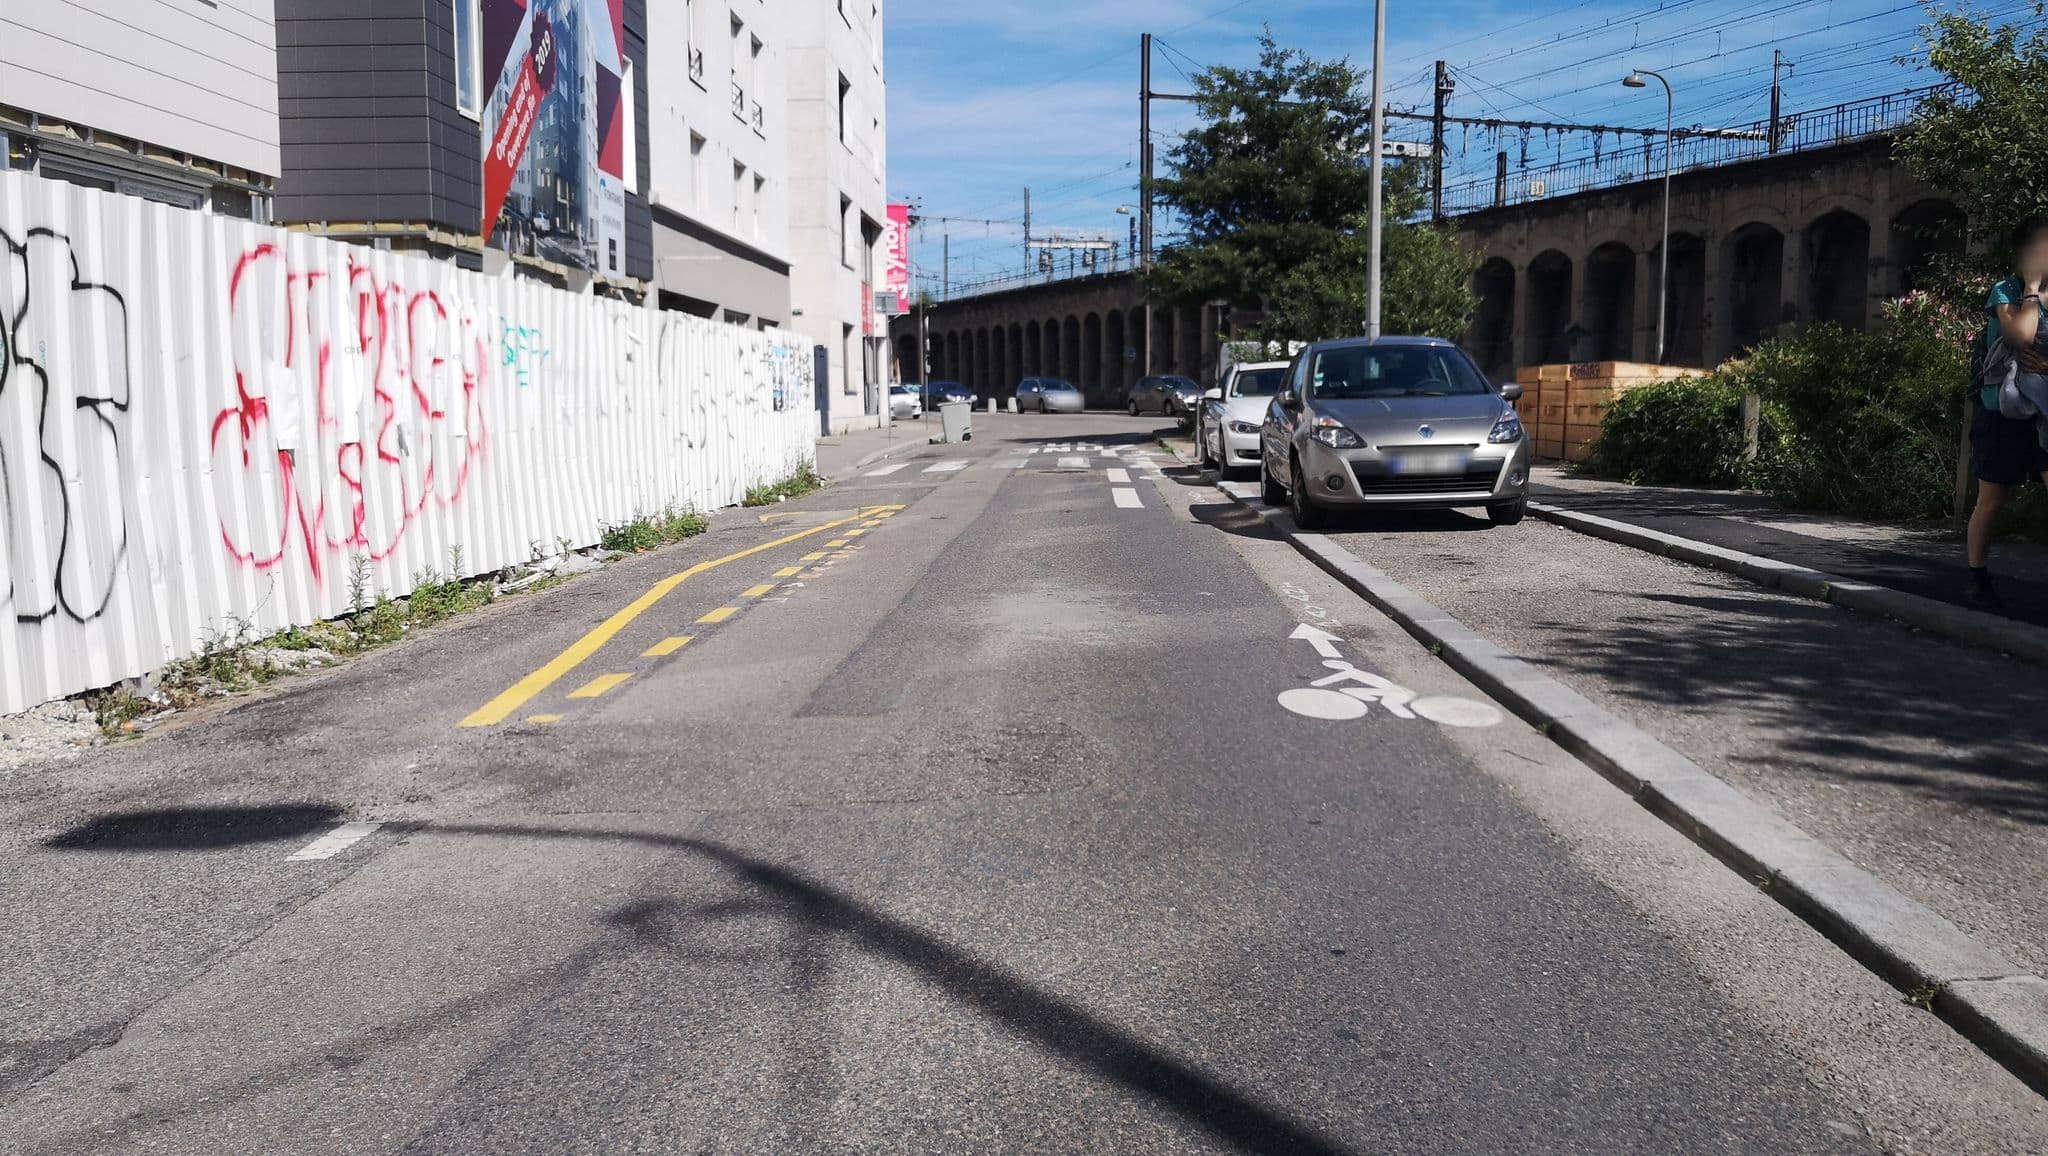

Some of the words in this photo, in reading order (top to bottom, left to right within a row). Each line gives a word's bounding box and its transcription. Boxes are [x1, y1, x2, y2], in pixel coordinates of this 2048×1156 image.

[535, 30, 551, 74] 2019
[495, 110, 519, 161] Opening
[524, 68, 532, 92] of
[506, 110, 530, 169] Ouverture
[527, 93, 537, 119] fin
